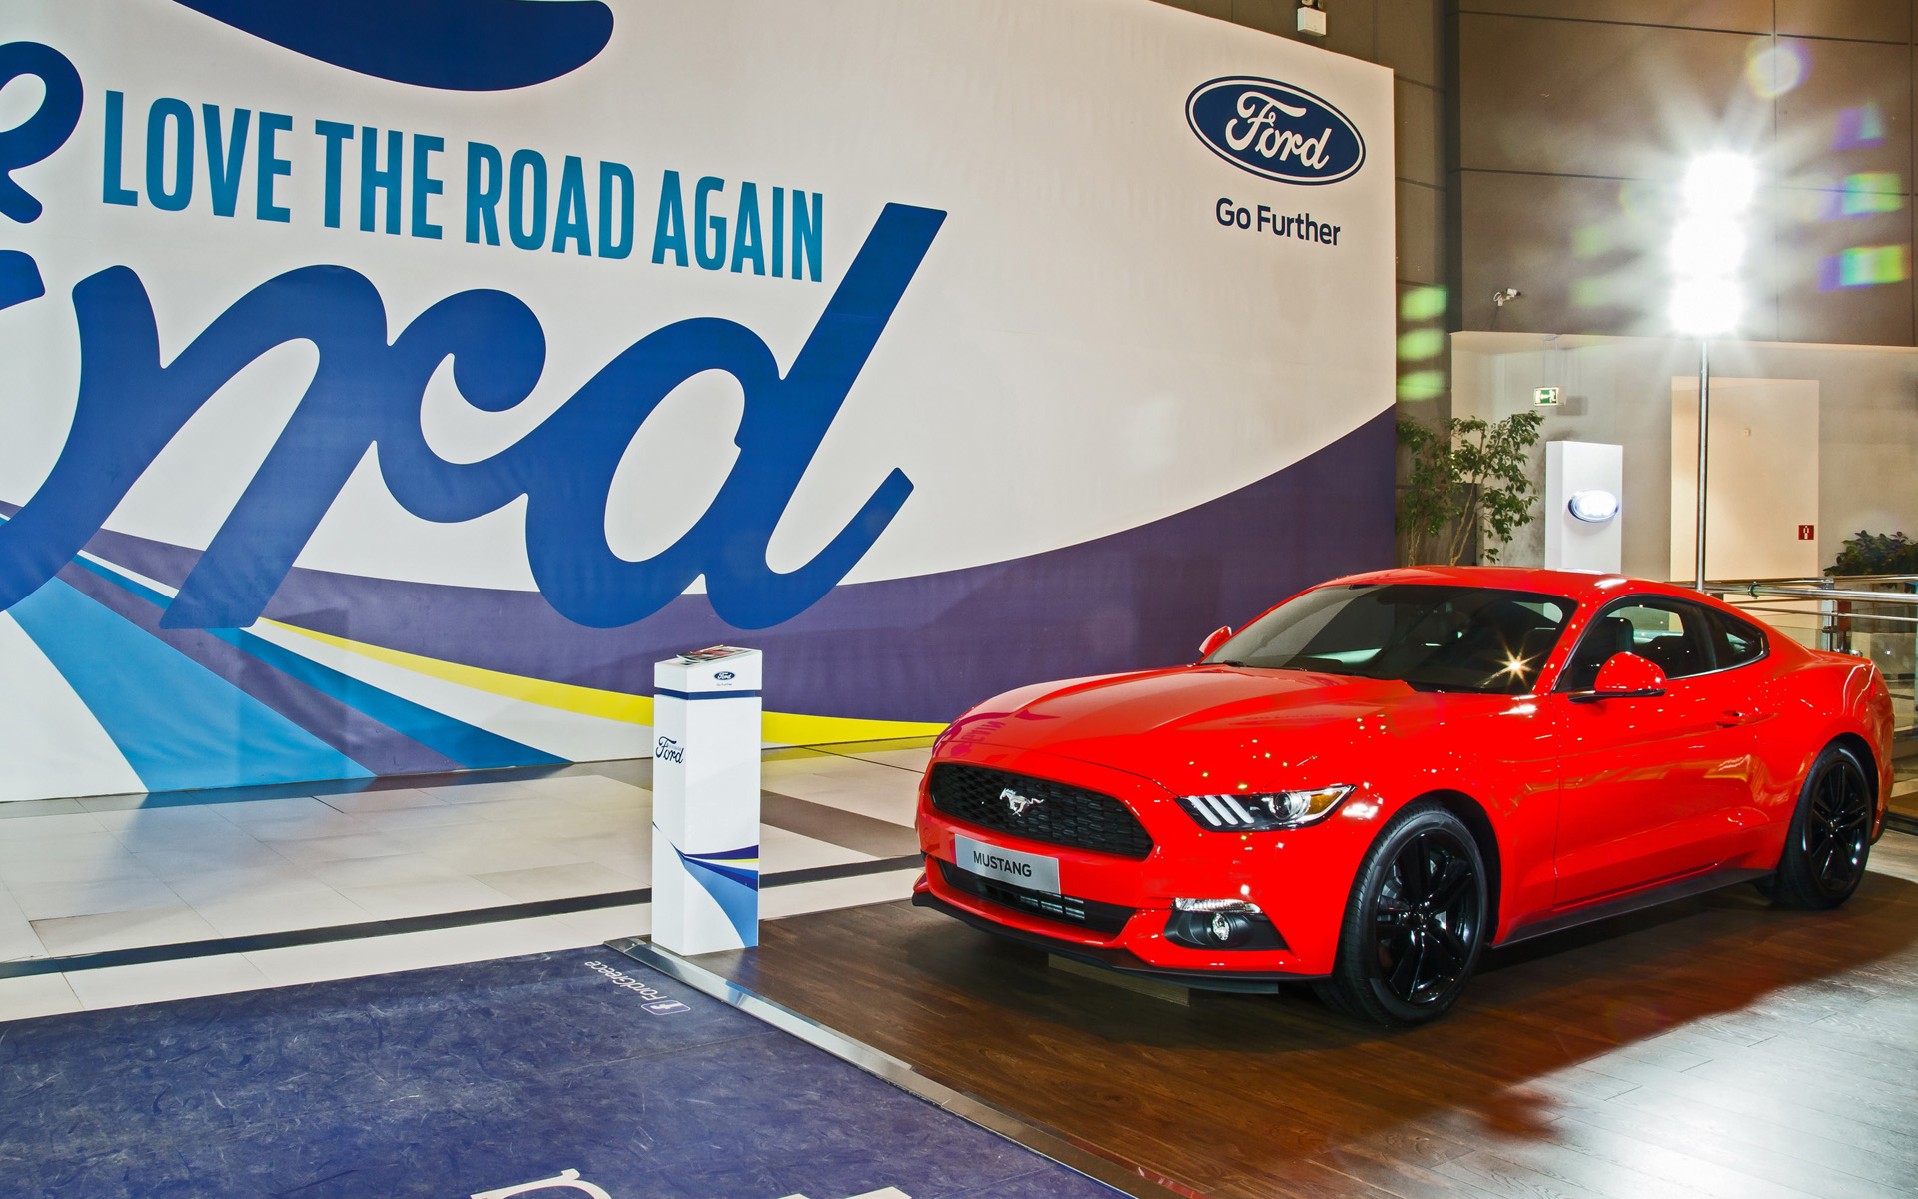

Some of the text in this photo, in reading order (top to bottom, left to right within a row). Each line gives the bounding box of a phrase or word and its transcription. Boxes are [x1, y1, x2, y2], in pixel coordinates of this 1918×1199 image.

[1225, 91, 1332, 170] Ford
[103, 91, 823, 283] LOVE THE ROAD AGAIN
[1216, 197, 1341, 246] Go Further
[655, 735, 684, 764] Ford
[973, 850, 1032, 877] MUSTANG
[584, 960, 668, 1001] FordGreece
